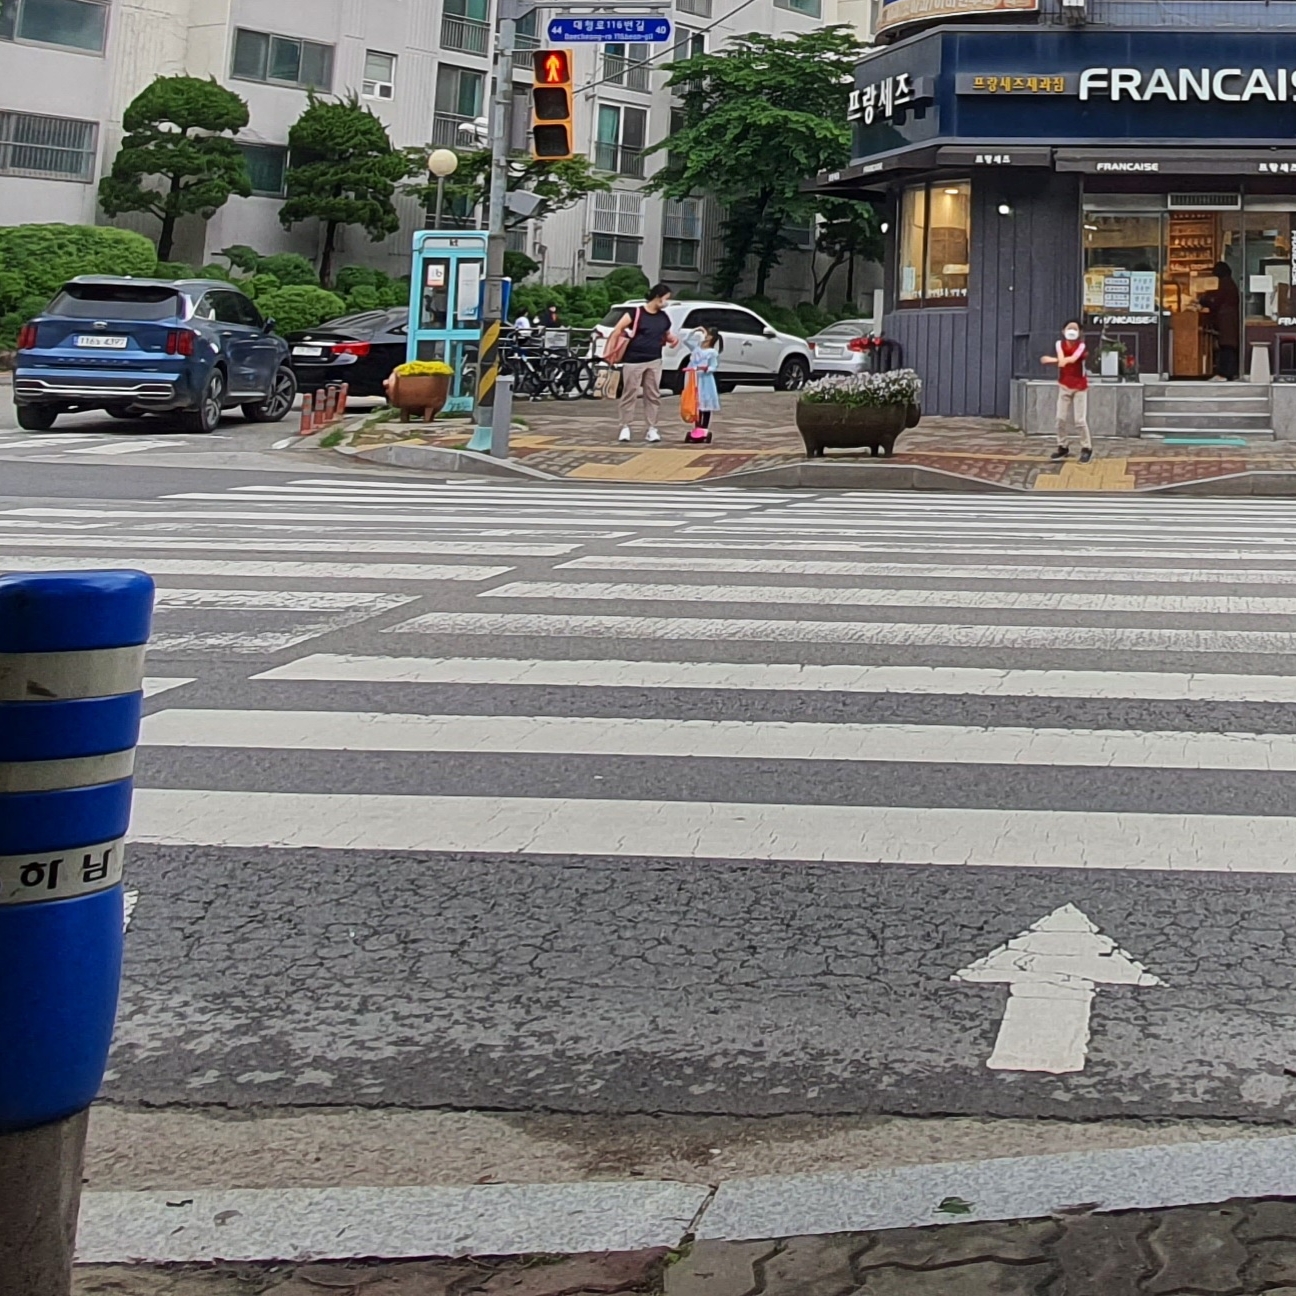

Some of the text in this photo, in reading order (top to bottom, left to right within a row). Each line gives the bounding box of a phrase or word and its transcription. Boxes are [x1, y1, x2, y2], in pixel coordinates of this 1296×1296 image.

[847, 73, 911, 125] 프랑세즈
[973, 76, 1065, 93] 프랑세즈제과점
[1097, 163, 1158, 172] FRANCAISE
[20, 848, 113, 890] 하남
